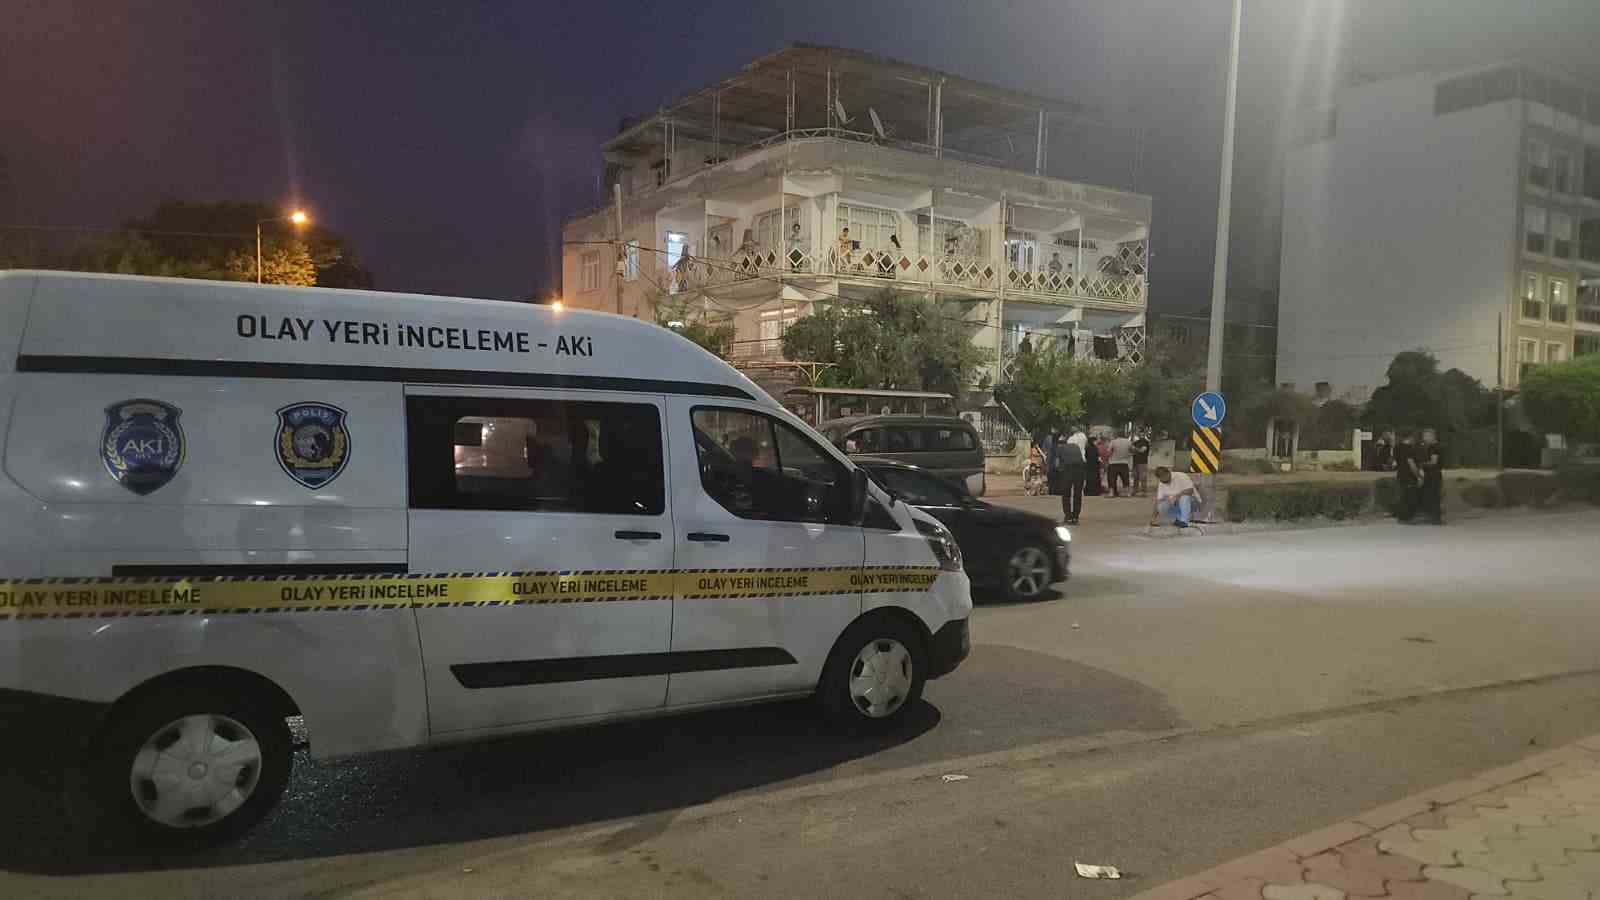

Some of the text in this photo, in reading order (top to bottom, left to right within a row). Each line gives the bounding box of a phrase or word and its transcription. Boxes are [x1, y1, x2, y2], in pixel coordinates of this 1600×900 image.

[236, 314, 315, 342] OLAY
[512, 581, 547, 595] OLAY
[698, 577, 728, 590] OLAY
[280, 585, 325, 601] OLAY
